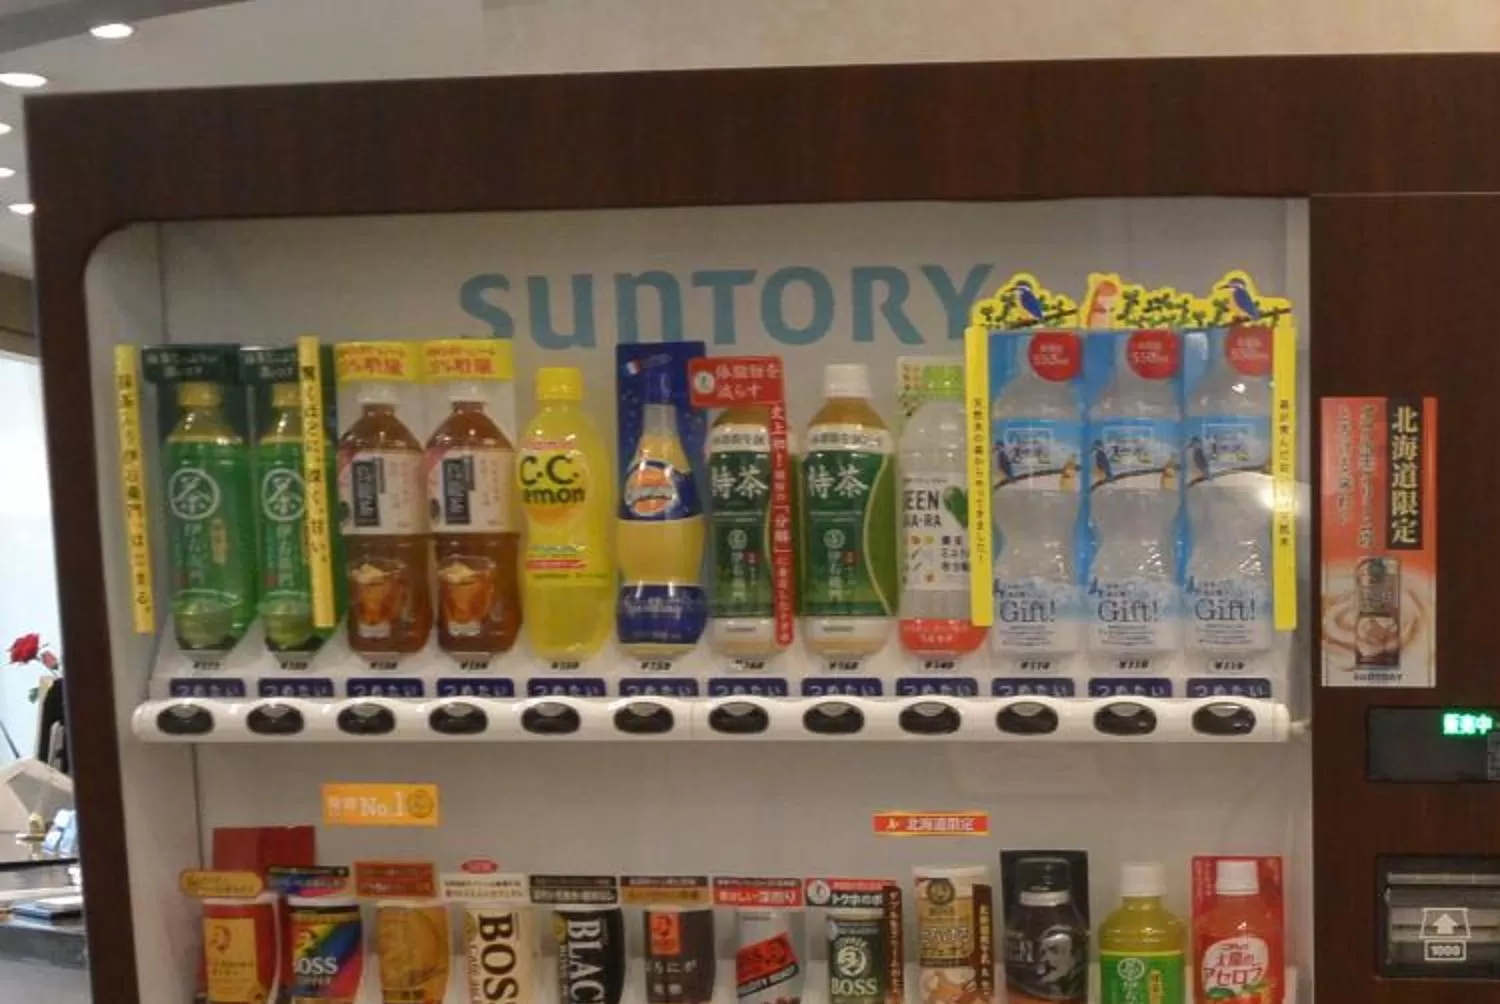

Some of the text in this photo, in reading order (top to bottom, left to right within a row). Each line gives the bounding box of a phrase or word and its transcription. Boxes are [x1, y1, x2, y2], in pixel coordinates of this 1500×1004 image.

[710, 465, 769, 499] 特茶
[808, 463, 869, 500] 特茶
[1391, 404, 1421, 544] 北海道限定
[523, 486, 586, 505] emon
[999, 597, 1056, 624] Gift!
[1097, 597, 1159, 624] Gift!
[1194, 596, 1257, 623] Gift!
[831, 977, 879, 996] BOSS
